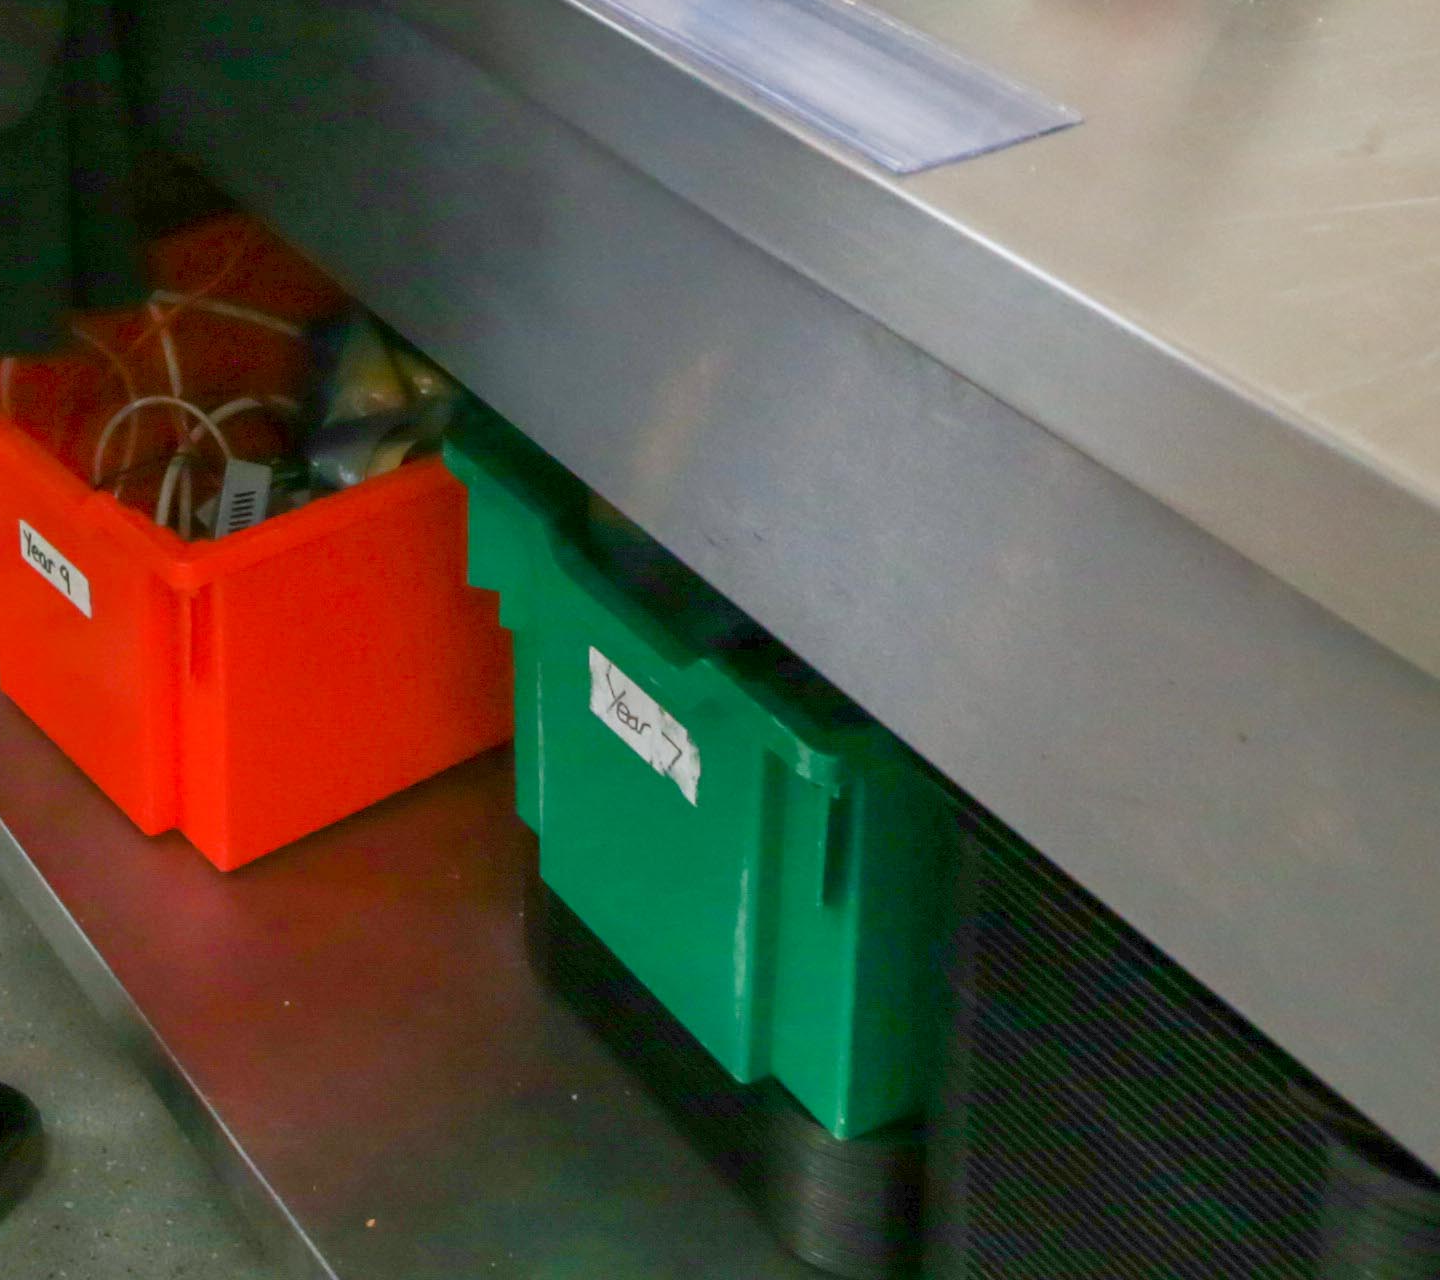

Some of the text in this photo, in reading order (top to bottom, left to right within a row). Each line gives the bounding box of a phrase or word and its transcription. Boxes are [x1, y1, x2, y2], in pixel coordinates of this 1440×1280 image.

[23, 529, 71, 596] Year 9
[606, 666, 651, 735] Year
